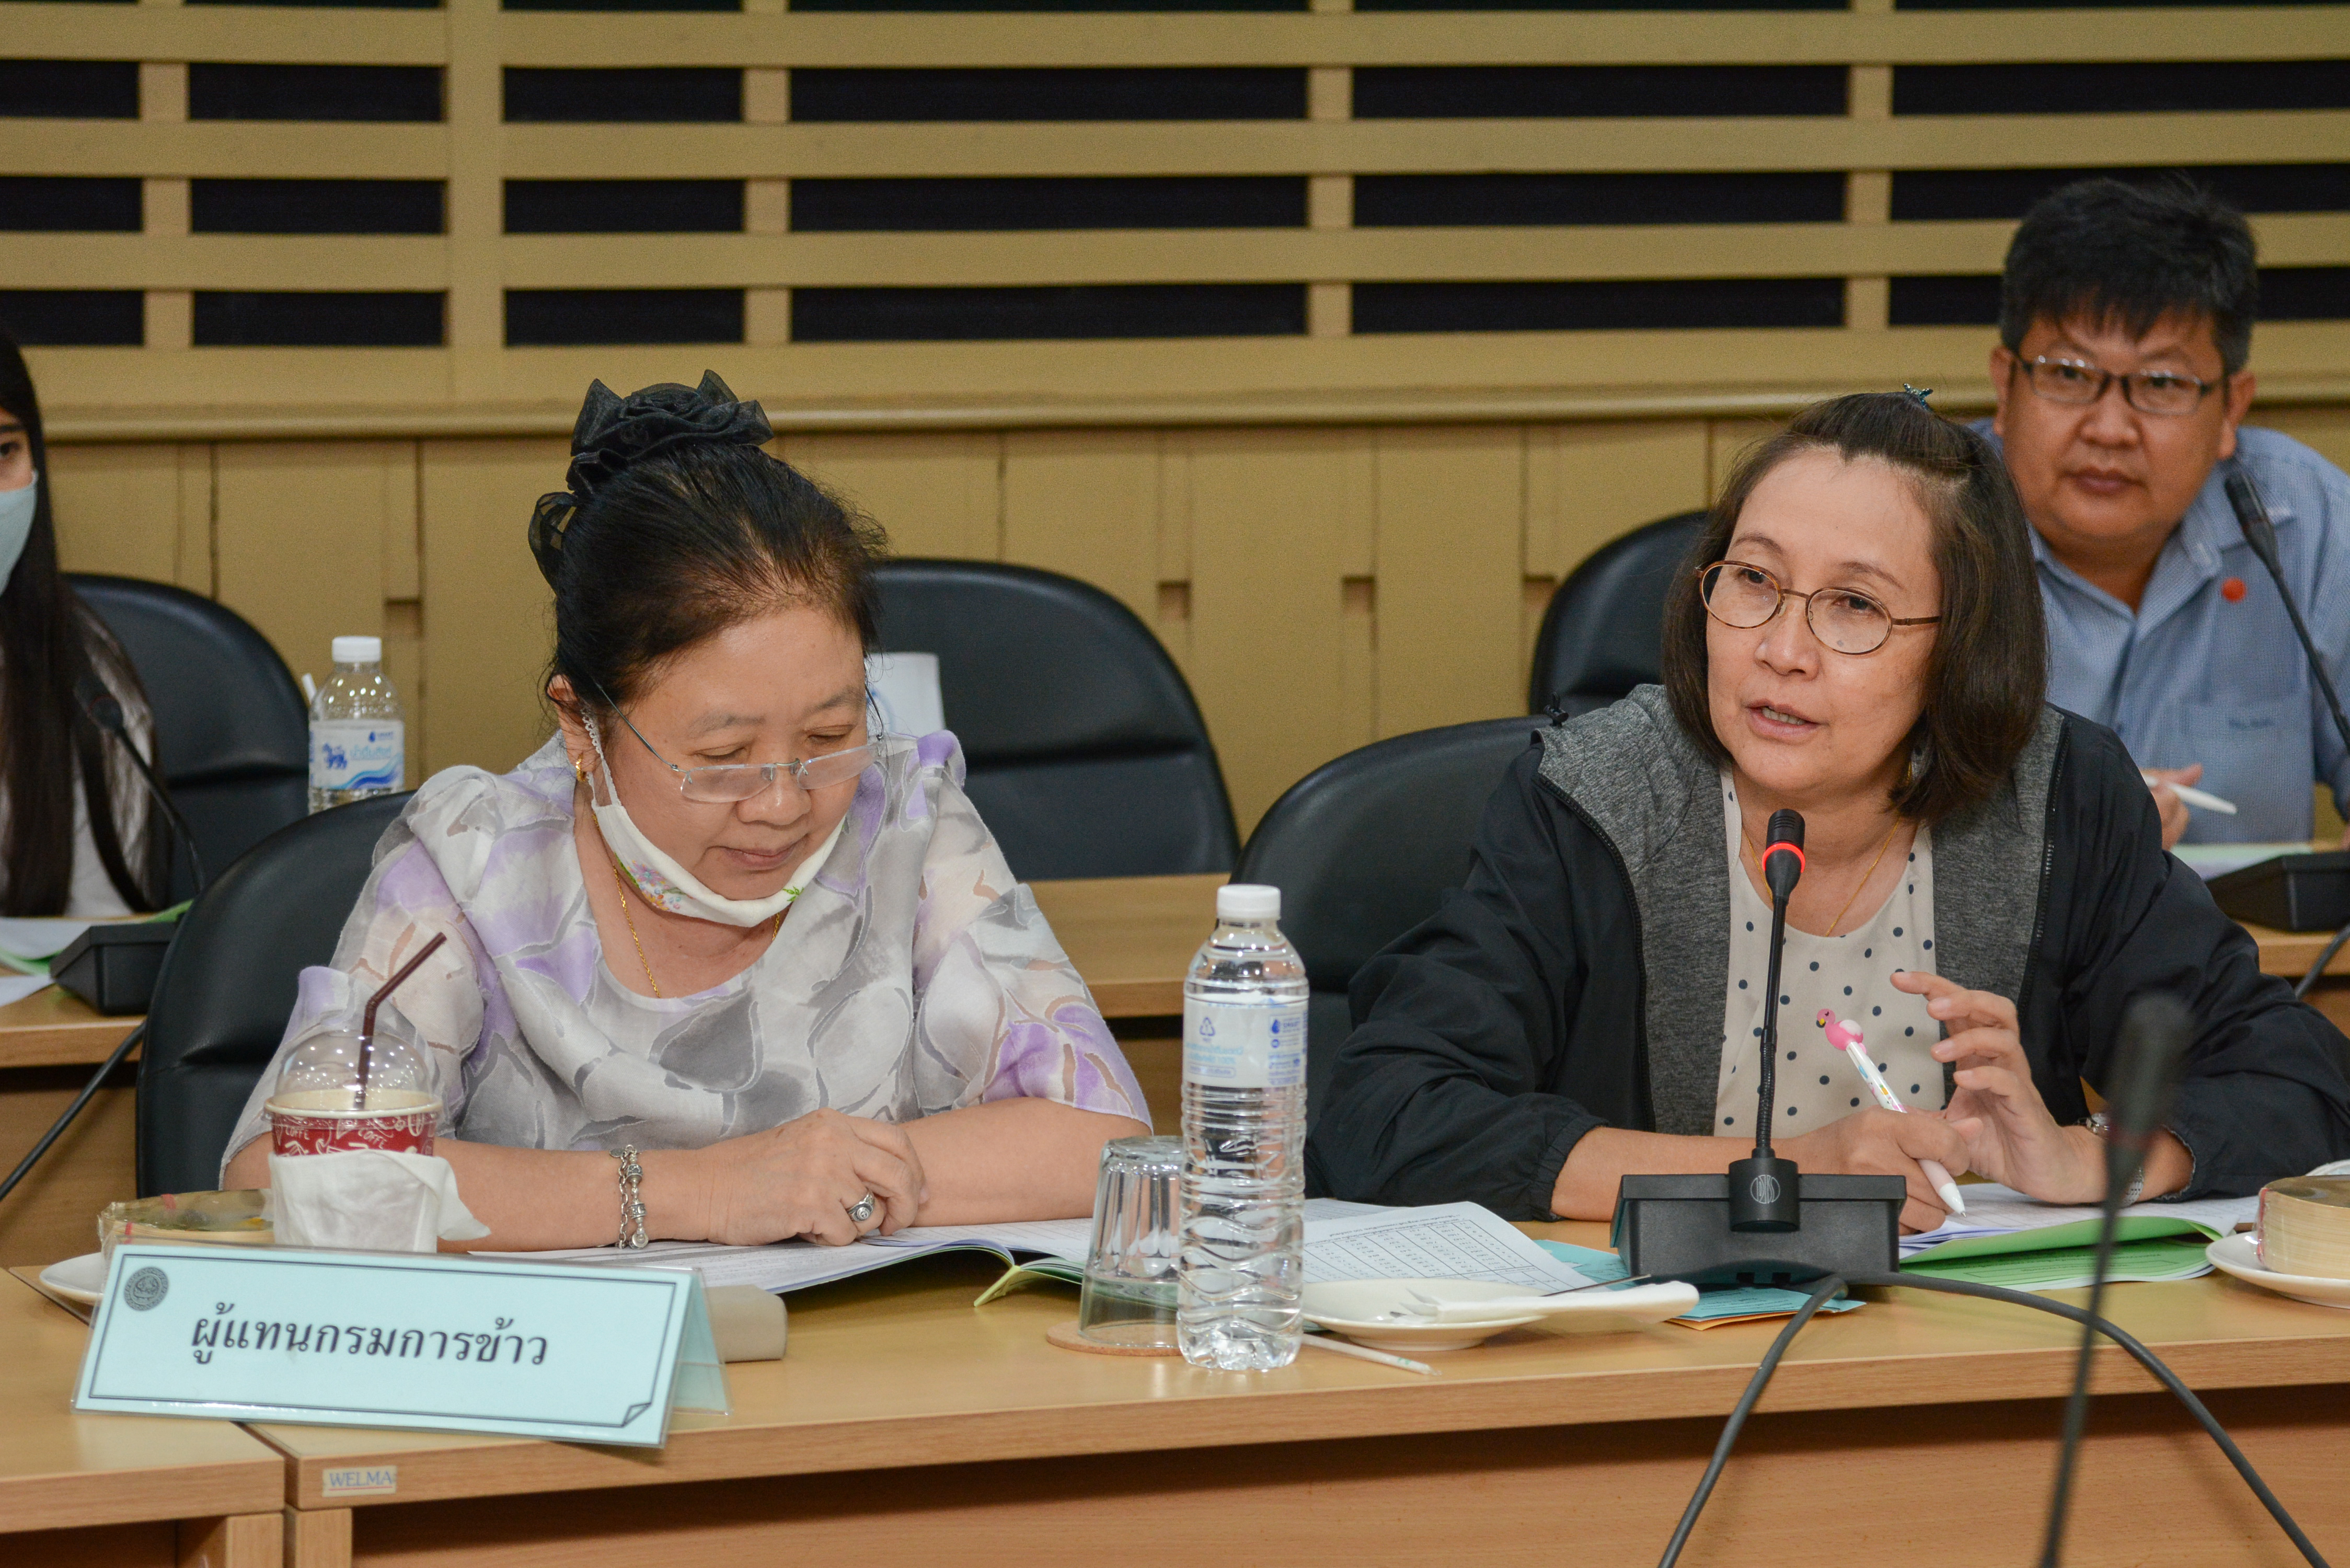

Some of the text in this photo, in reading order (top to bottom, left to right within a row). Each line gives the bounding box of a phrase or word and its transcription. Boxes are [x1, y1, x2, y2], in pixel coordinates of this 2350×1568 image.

[285, 1125, 310, 1140] COFFE
[358, 1127, 387, 1150] COFFE
[191, 1302, 548, 1366] ผู้แทนกรมการข้าว
[329, 1470, 393, 1488] WELMA
